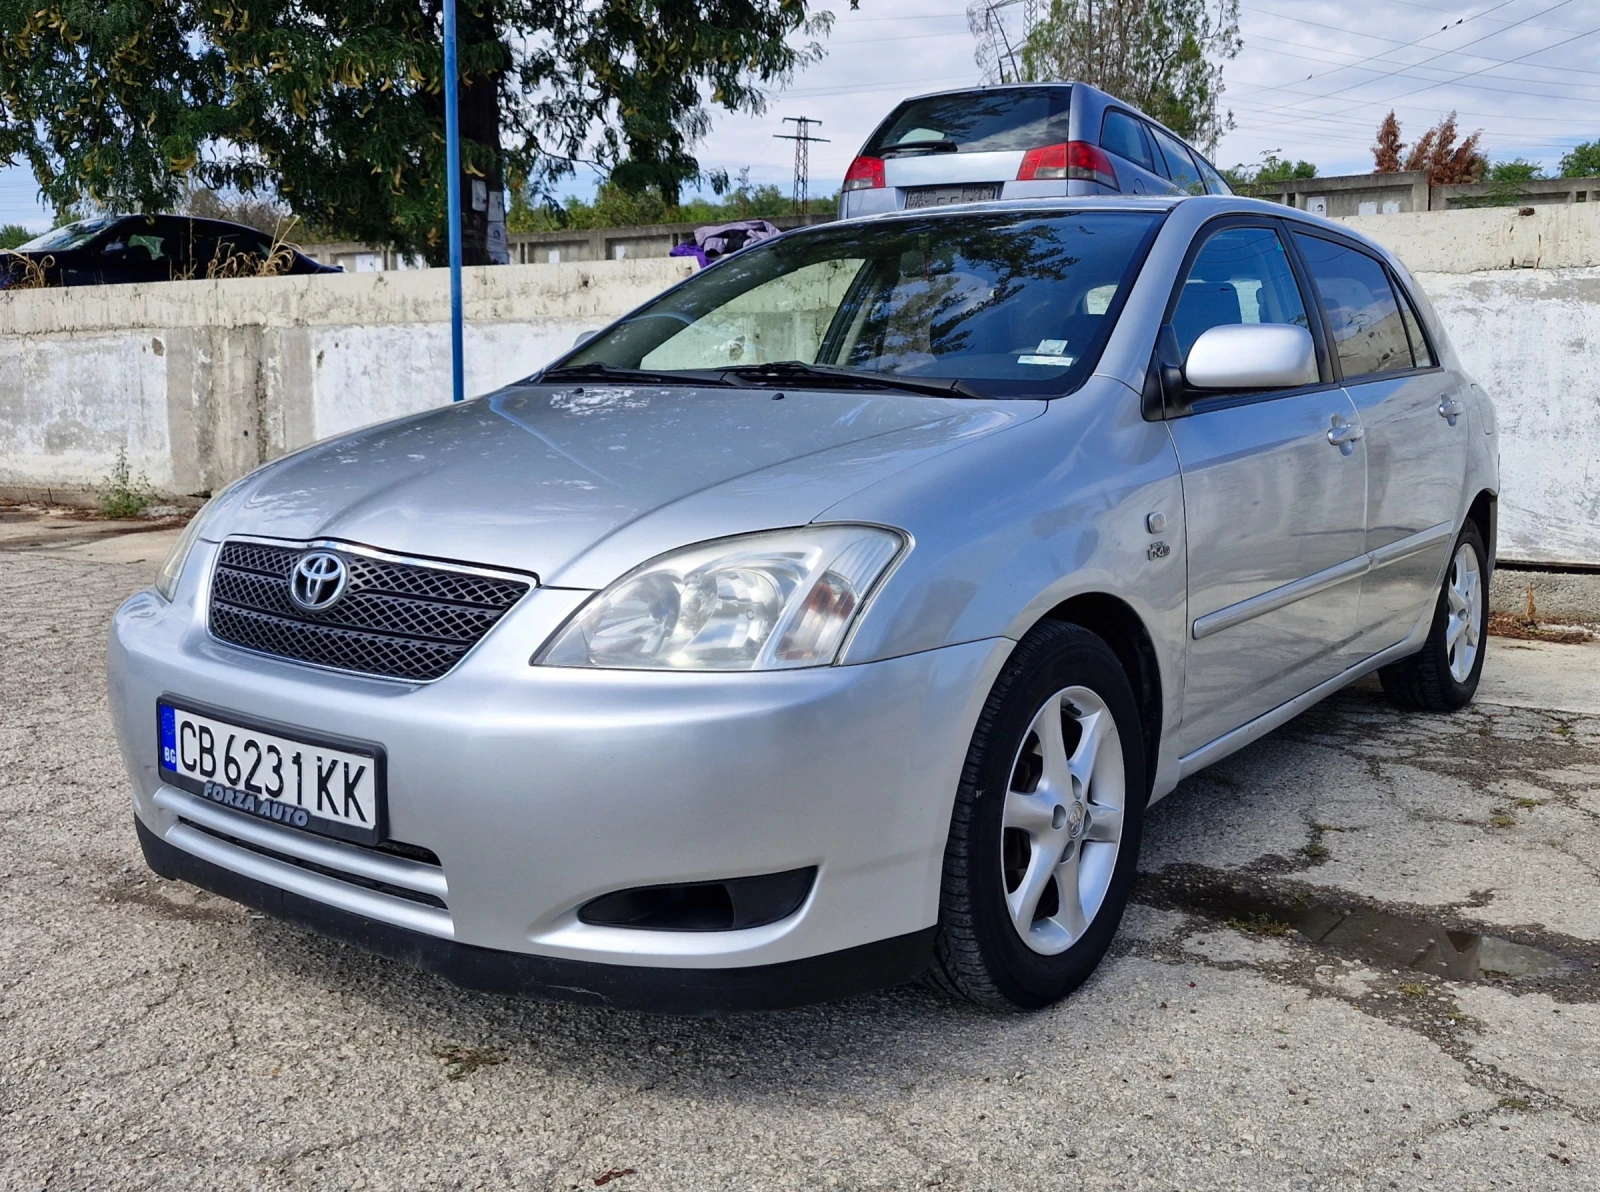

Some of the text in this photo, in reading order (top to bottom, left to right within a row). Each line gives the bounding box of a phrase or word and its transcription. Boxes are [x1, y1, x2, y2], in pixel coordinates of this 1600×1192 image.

[164, 746, 176, 764] BG
[203, 780, 308, 827] FORZA AUTO
